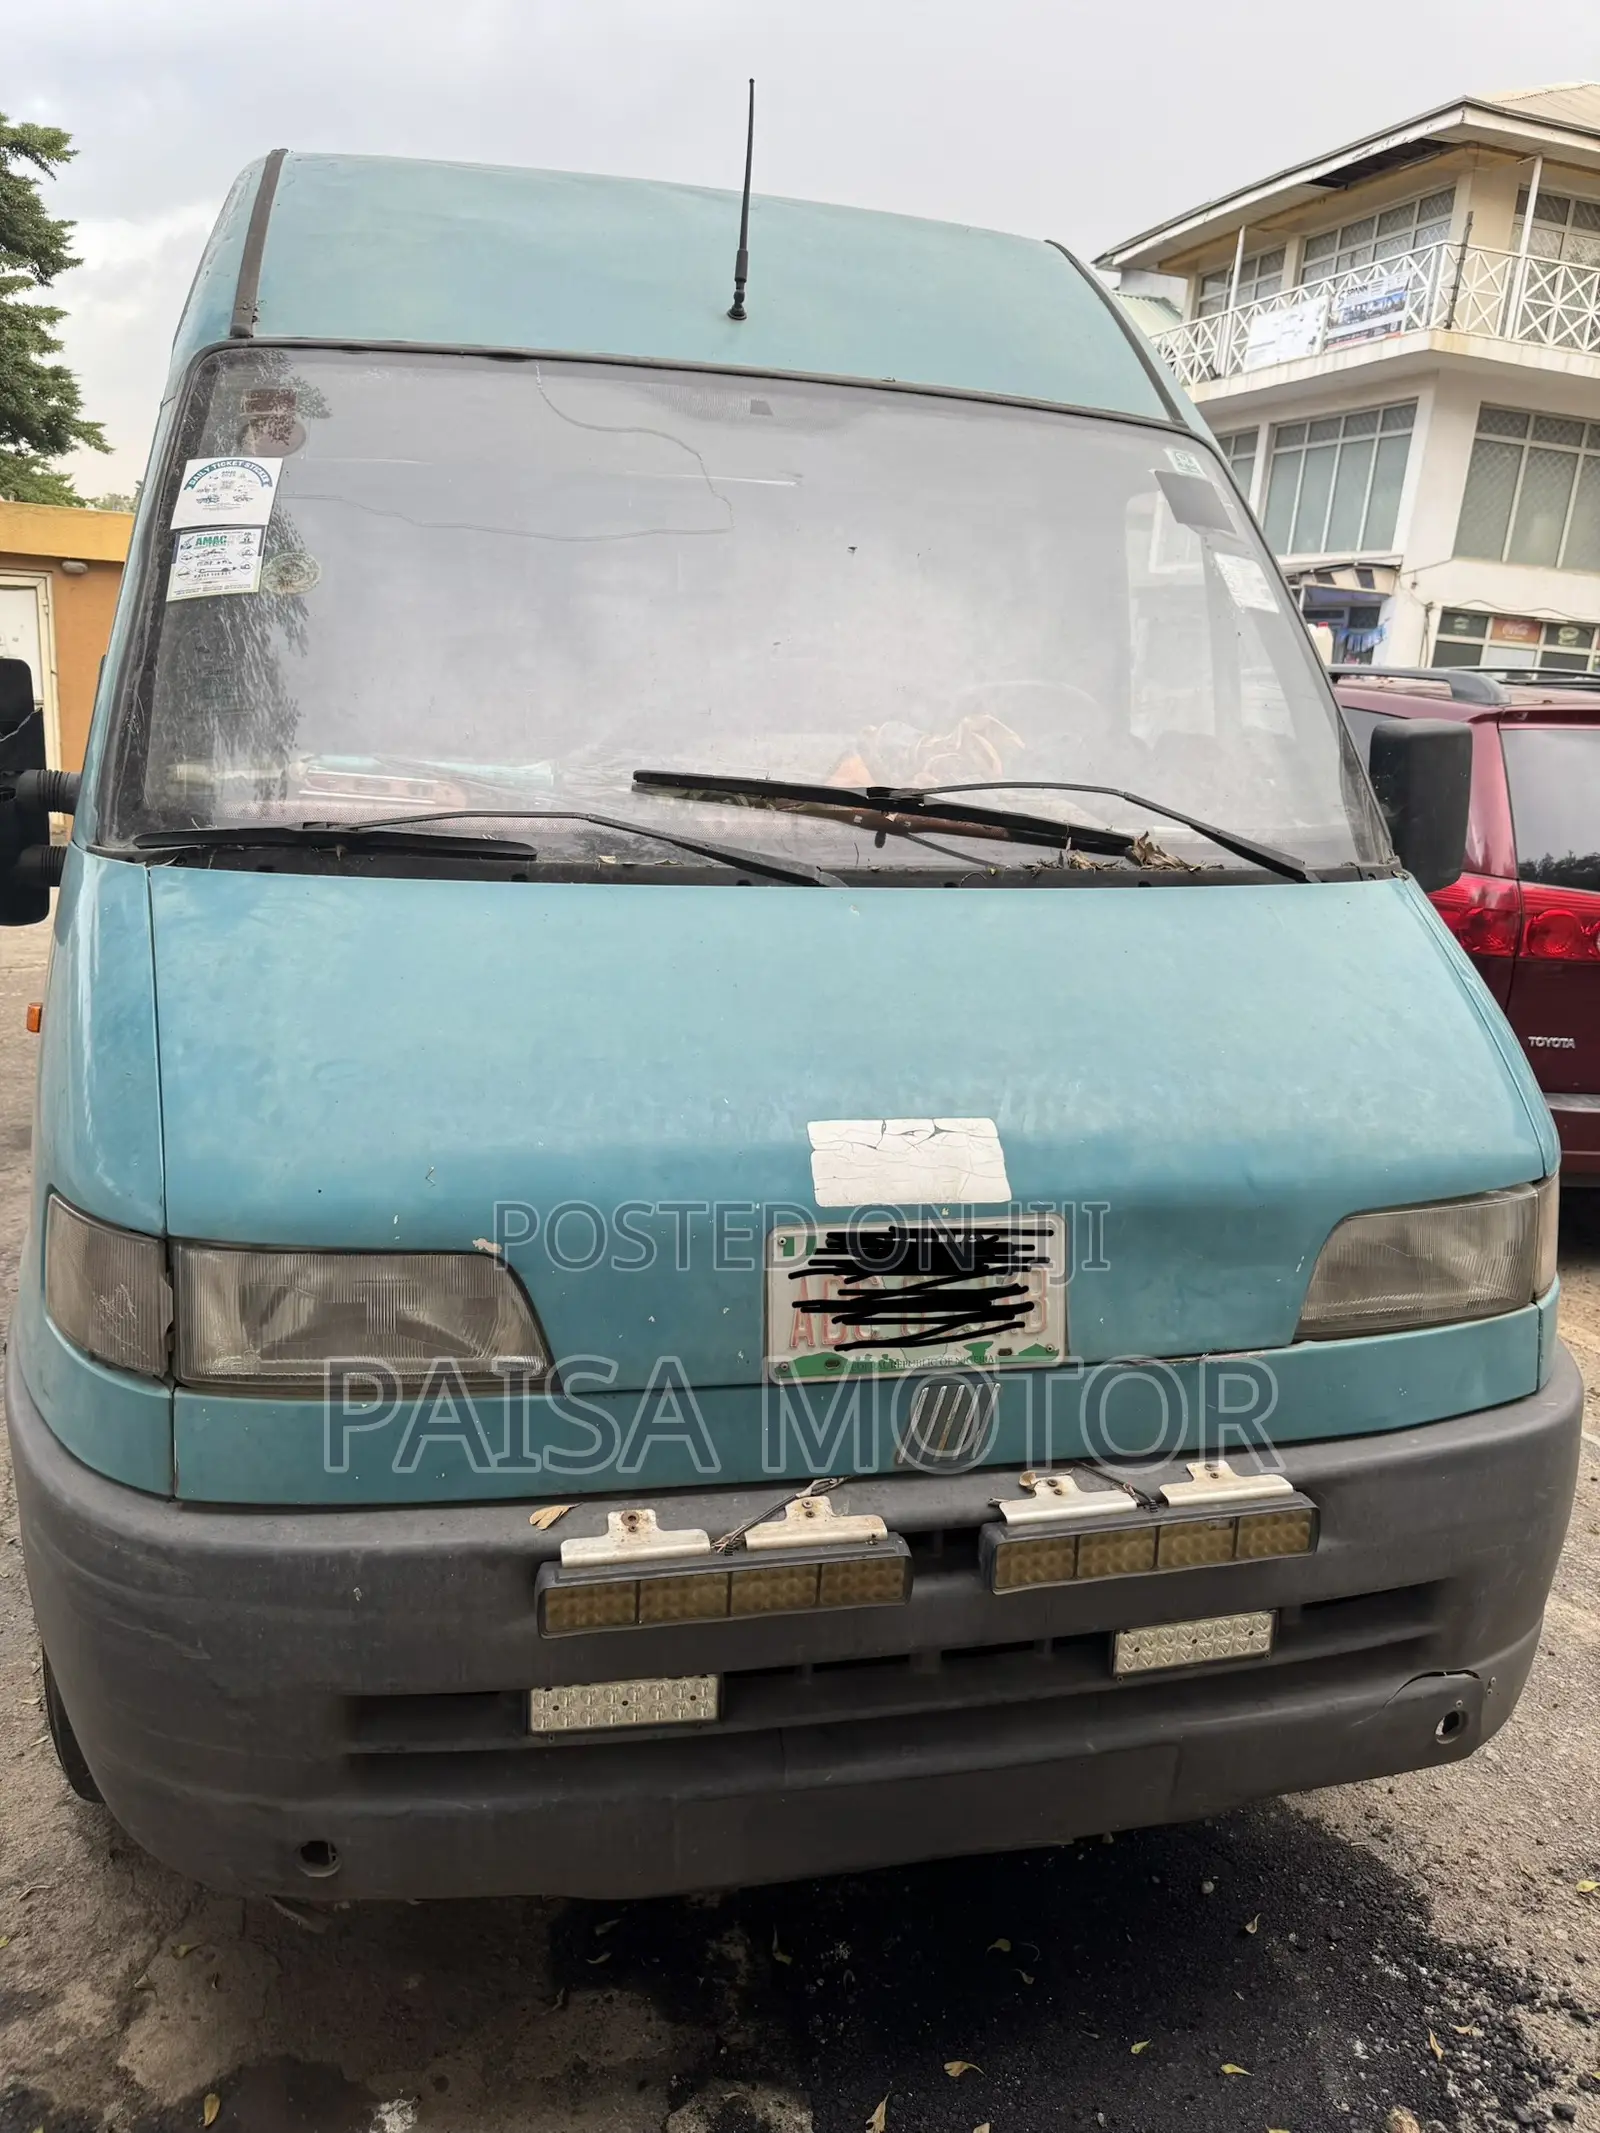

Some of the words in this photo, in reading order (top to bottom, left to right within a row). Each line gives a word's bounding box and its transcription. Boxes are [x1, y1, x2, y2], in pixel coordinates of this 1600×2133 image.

[189, 466, 211, 486] DAILY
[213, 460, 243, 471] TICKET
[195, 535, 227, 547] AMAC
[1527, 1035, 1576, 1049] TOYOTA
[939, 1358, 953, 1367] OF
